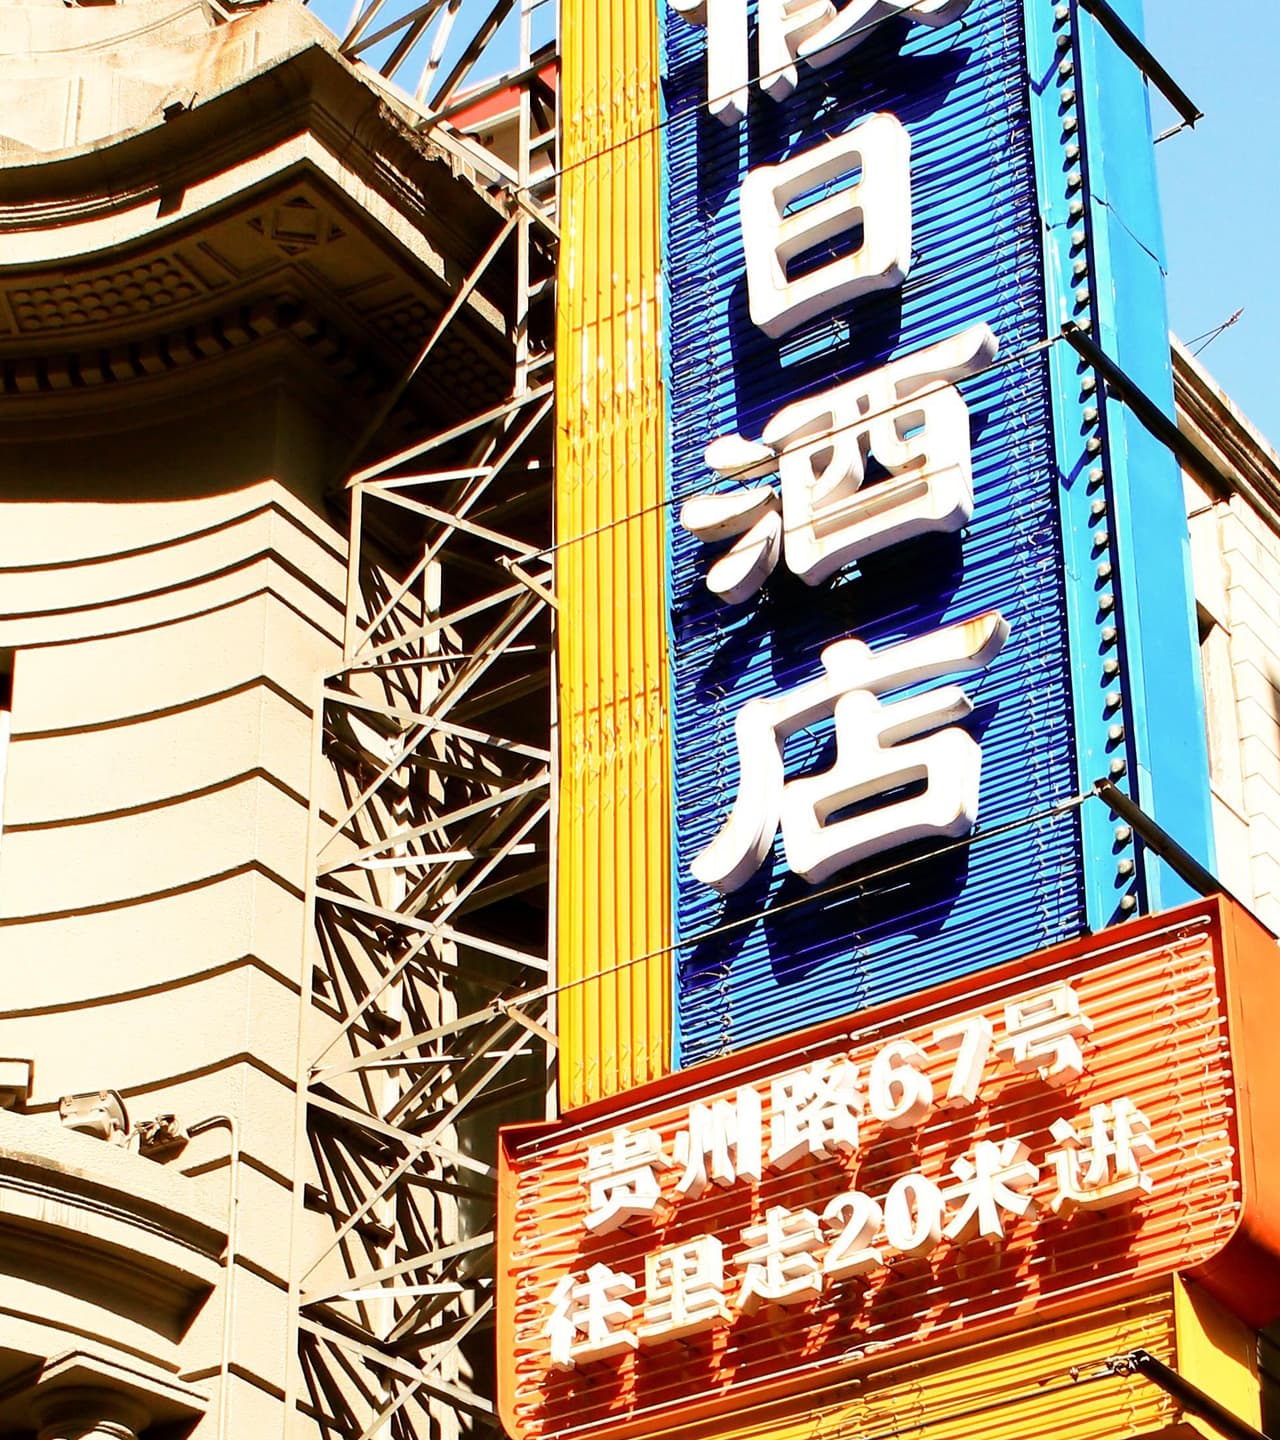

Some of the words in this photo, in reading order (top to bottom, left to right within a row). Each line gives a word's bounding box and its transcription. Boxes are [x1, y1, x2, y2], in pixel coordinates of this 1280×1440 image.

[545, 1096, 1157, 1372] 往里走20米进
[578, 979, 1094, 1236] 贵州路67号
